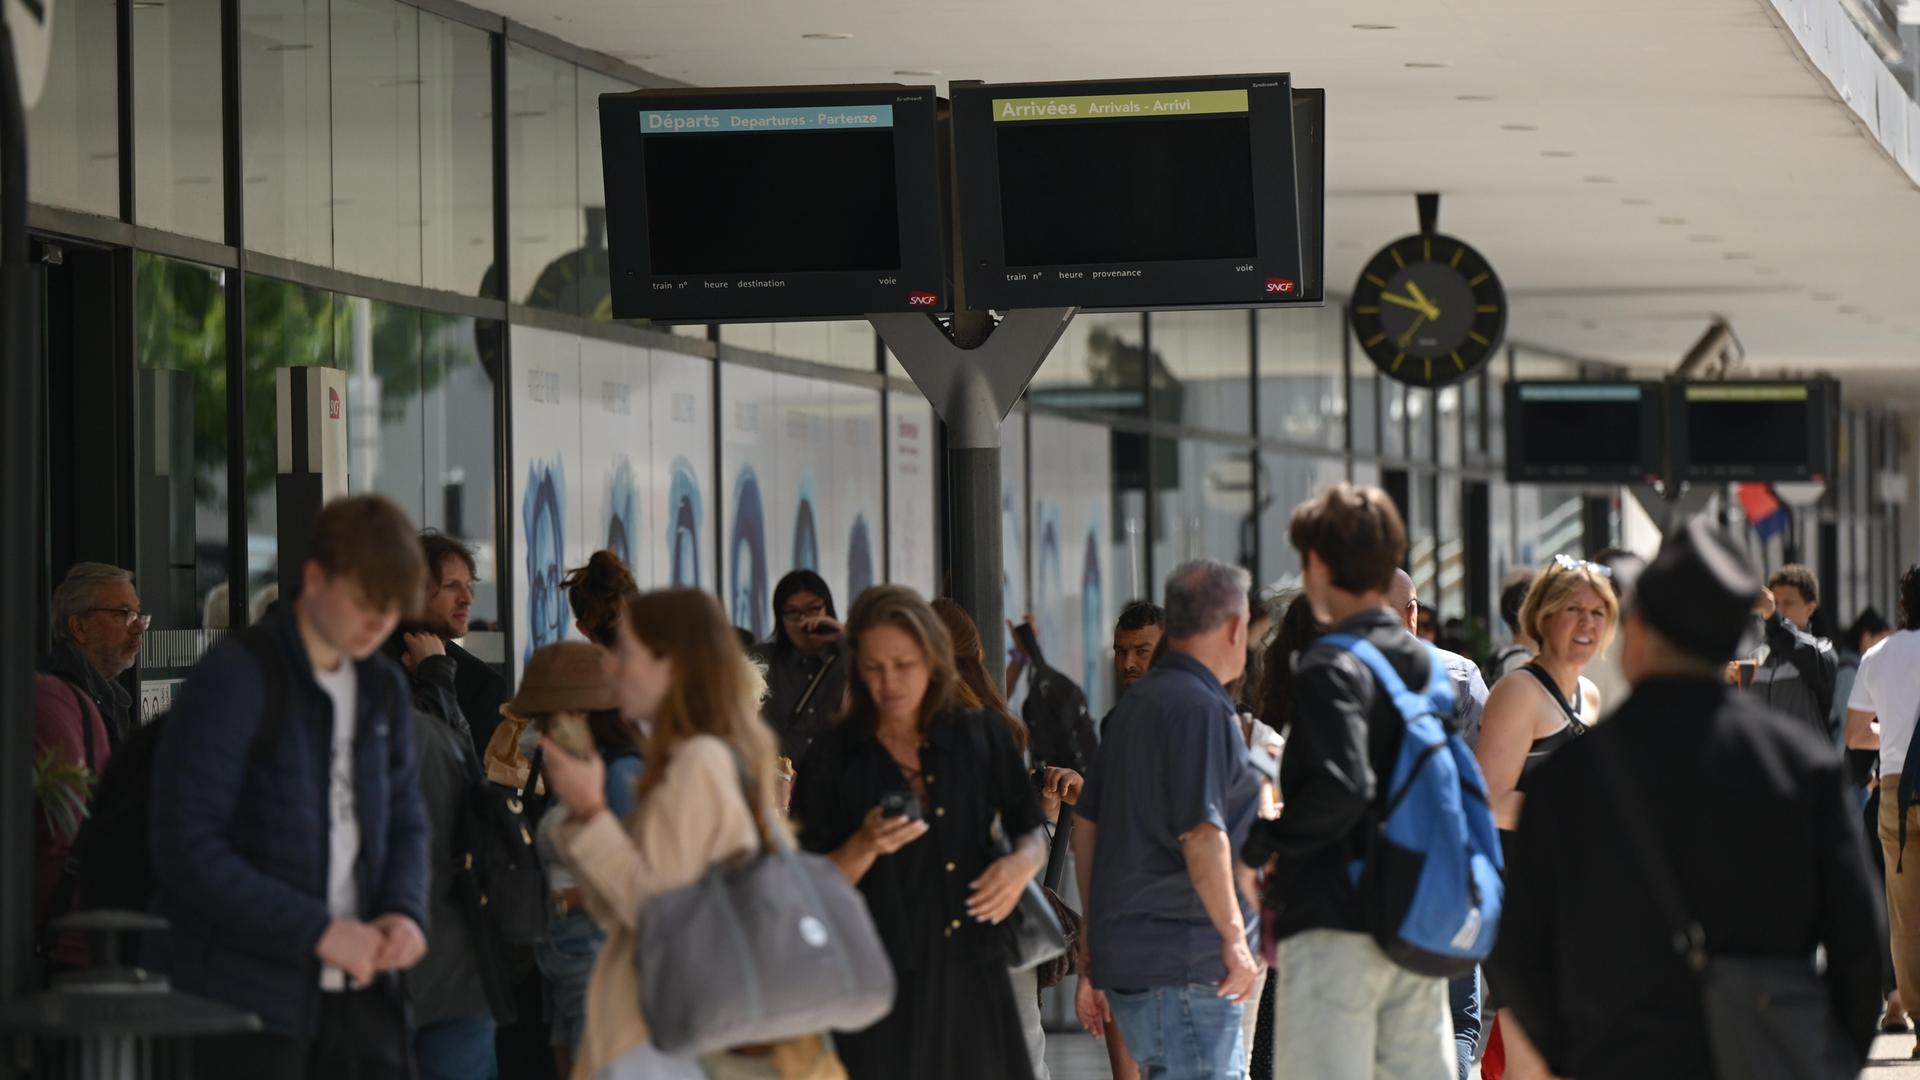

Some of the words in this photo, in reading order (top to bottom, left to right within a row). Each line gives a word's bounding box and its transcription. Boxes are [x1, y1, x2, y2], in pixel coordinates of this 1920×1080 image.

[1001, 100, 1078, 117] Arrivées
[1089, 100, 1141, 114] Arrivals
[1153, 98, 1191, 112] Arrivi
[649, 112, 720, 131] Départs
[730, 115, 806, 129] Departures
[818, 112, 878, 126] Partenze
[1235, 264, 1254, 273] voie
[1006, 273, 1027, 281] train
[1059, 270, 1084, 279] heure
[1092, 269, 1142, 279] provenance
[652, 281, 673, 290] train
[704, 279, 729, 289] heure
[737, 278, 785, 288] destination
[879, 276, 897, 286] voie
[1266, 283, 1293, 292] SNCF
[909, 296, 936, 305] SNCF
